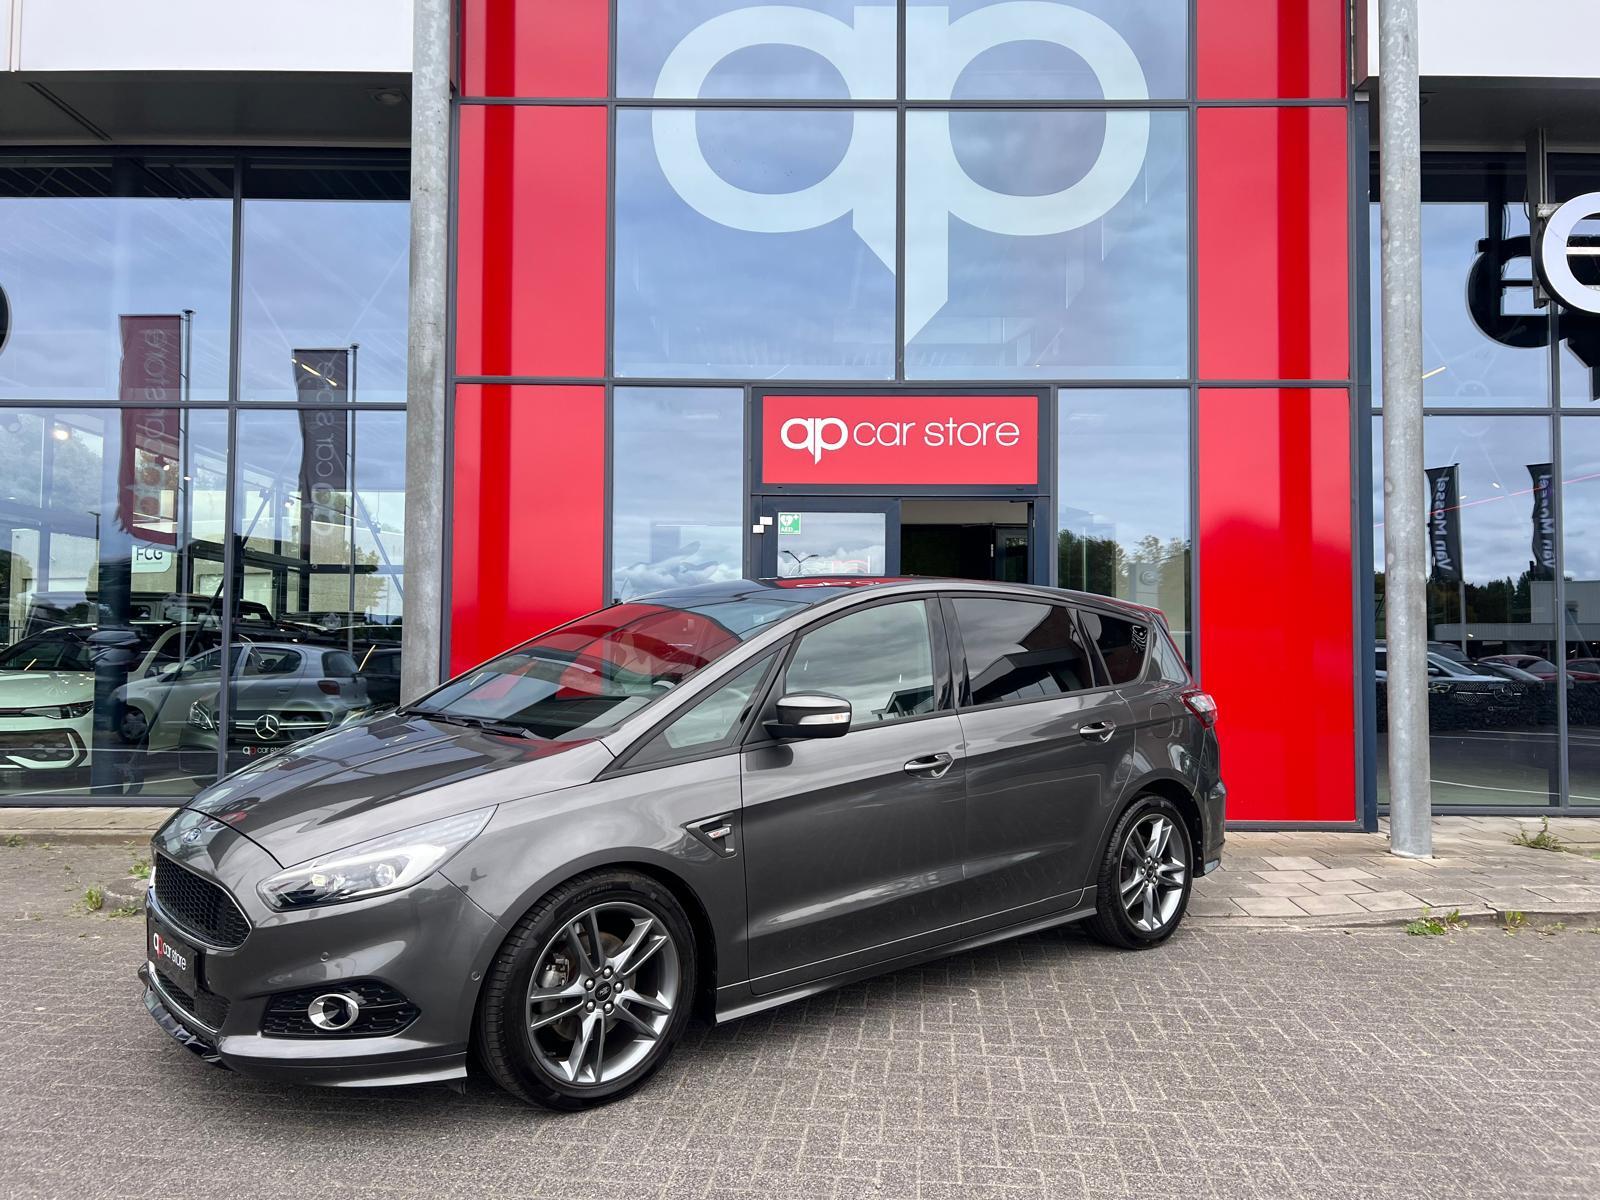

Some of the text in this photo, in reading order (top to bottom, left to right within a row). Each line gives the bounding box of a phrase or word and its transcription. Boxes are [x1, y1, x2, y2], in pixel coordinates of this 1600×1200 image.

[652, 1, 1150, 346] ap
[780, 417, 1020, 465] ap car store
[136, 547, 163, 561] FCG
[162, 942, 172, 959] car
[171, 949, 187, 971] store
